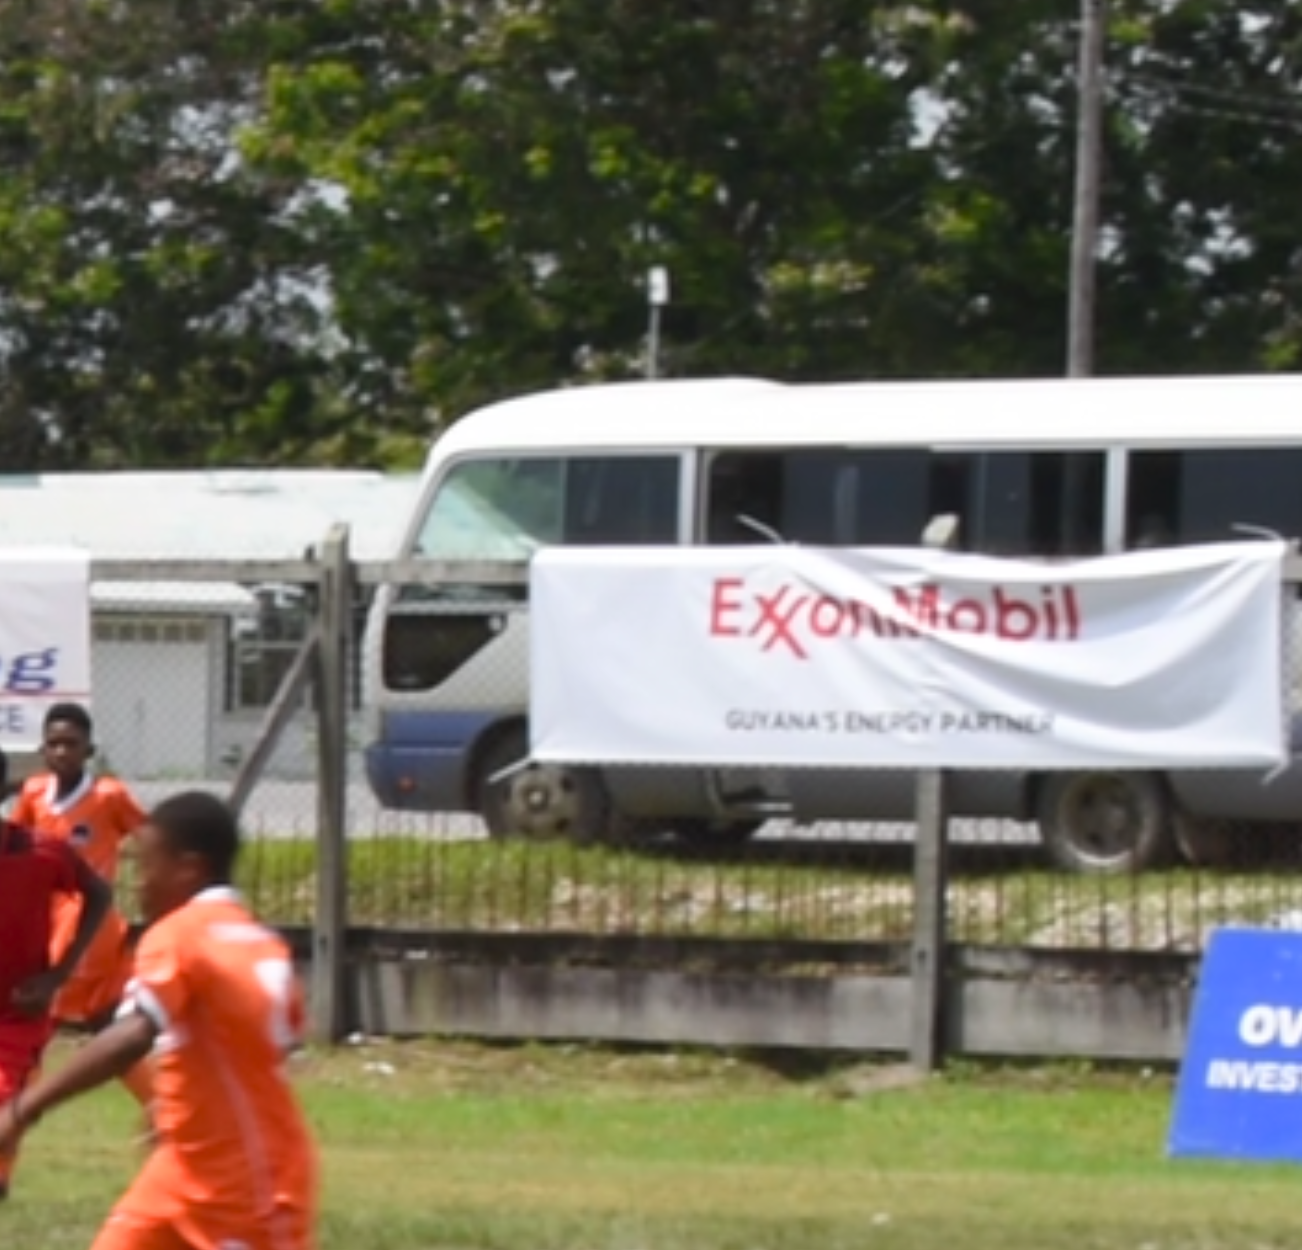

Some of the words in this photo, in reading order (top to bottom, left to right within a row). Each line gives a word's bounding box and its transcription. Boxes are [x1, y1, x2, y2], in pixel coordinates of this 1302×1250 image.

[710, 577, 1080, 660] ExxonMobil
[725, 709, 839, 733] GUYANA'S
[846, 710, 933, 735] ENERGY
